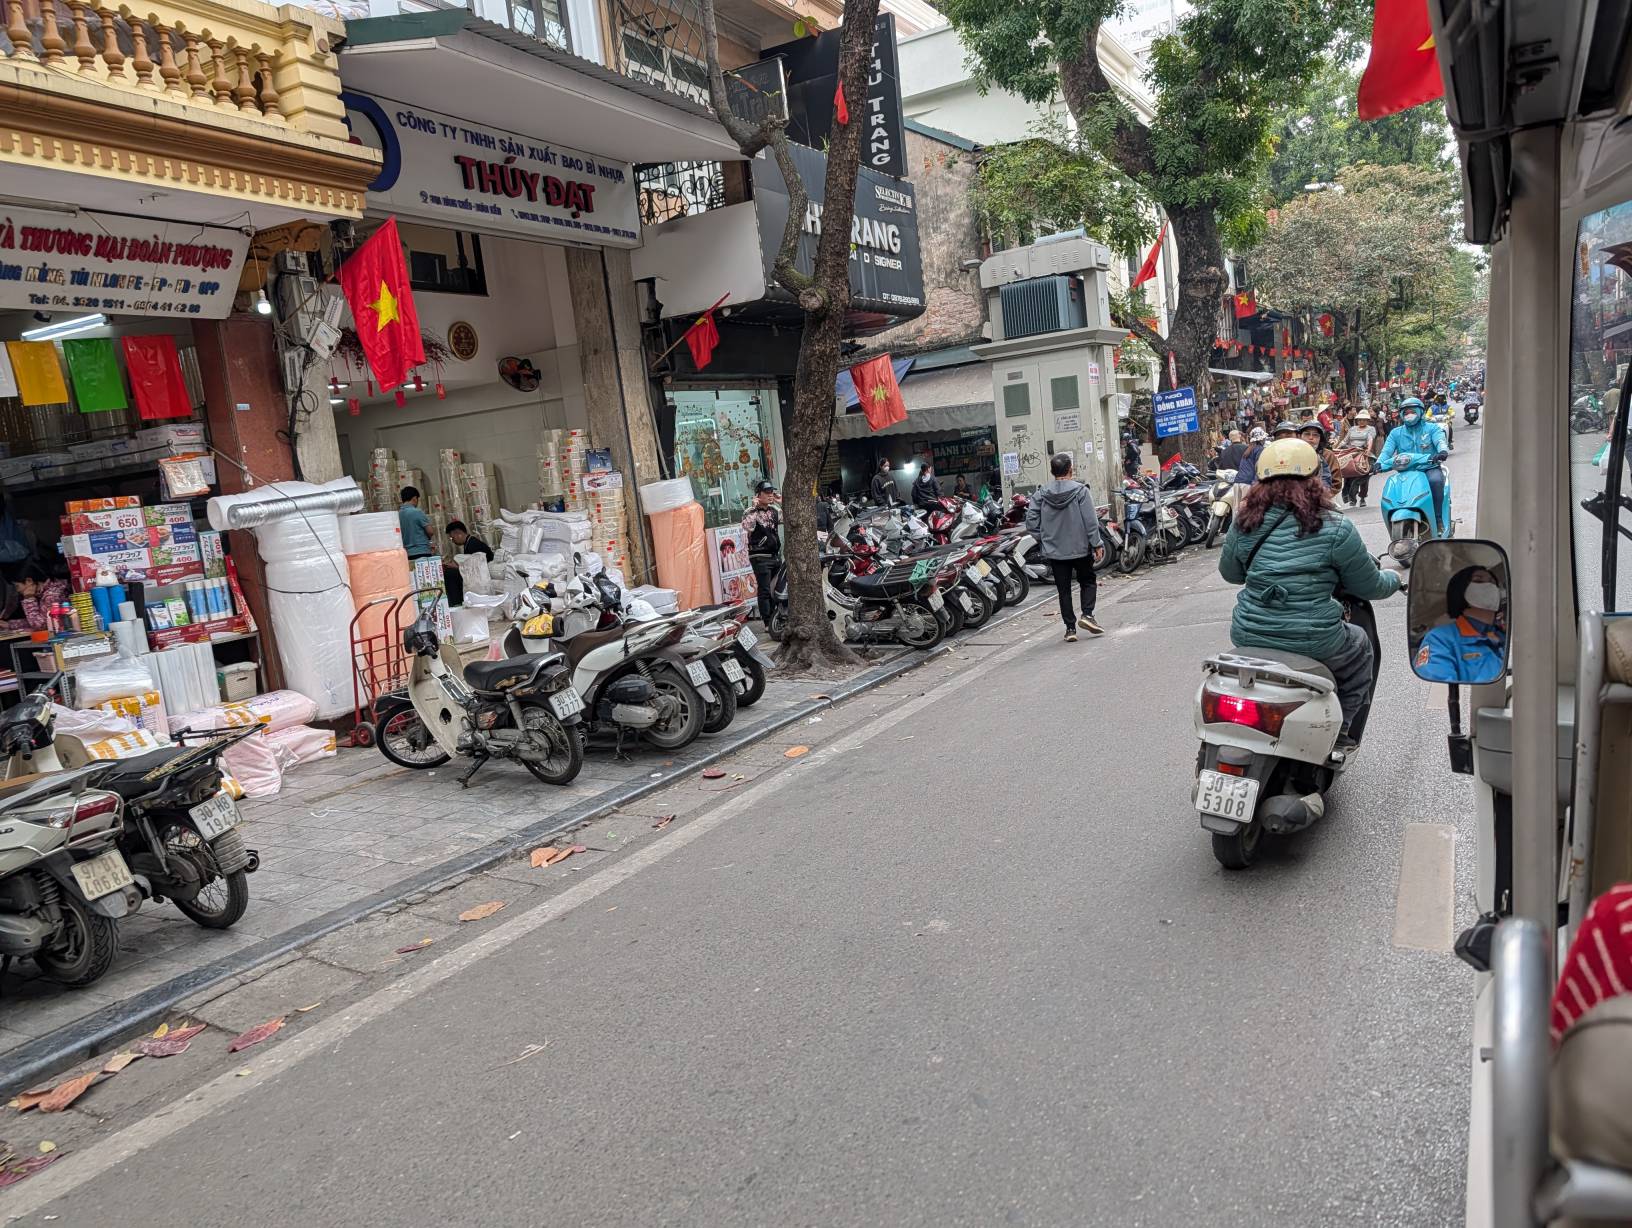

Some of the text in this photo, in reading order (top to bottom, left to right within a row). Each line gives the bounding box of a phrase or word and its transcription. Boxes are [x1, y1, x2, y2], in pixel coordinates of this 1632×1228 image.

[868, 96, 891, 165] TRANG
[396, 111, 626, 184] CÔNG TY TNHH SẢN XUẤT BAO BÌ NHỰA
[454, 155, 595, 219] THÚY ĐẠT
[20, 226, 94, 257] THƯƠNG
[94, 234, 127, 263] MẠI
[126, 234, 170, 265] ĐOÀN
[171, 243, 233, 273] PHƯỢNG
[851, 214, 901, 254] RANG
[118, 517, 138, 528] 650
[560, 698, 581, 716] 2777
[199, 797, 230, 822] 30-H8
[1202, 793, 1246, 818] 5308
[82, 870, 129, 897] 406.84
